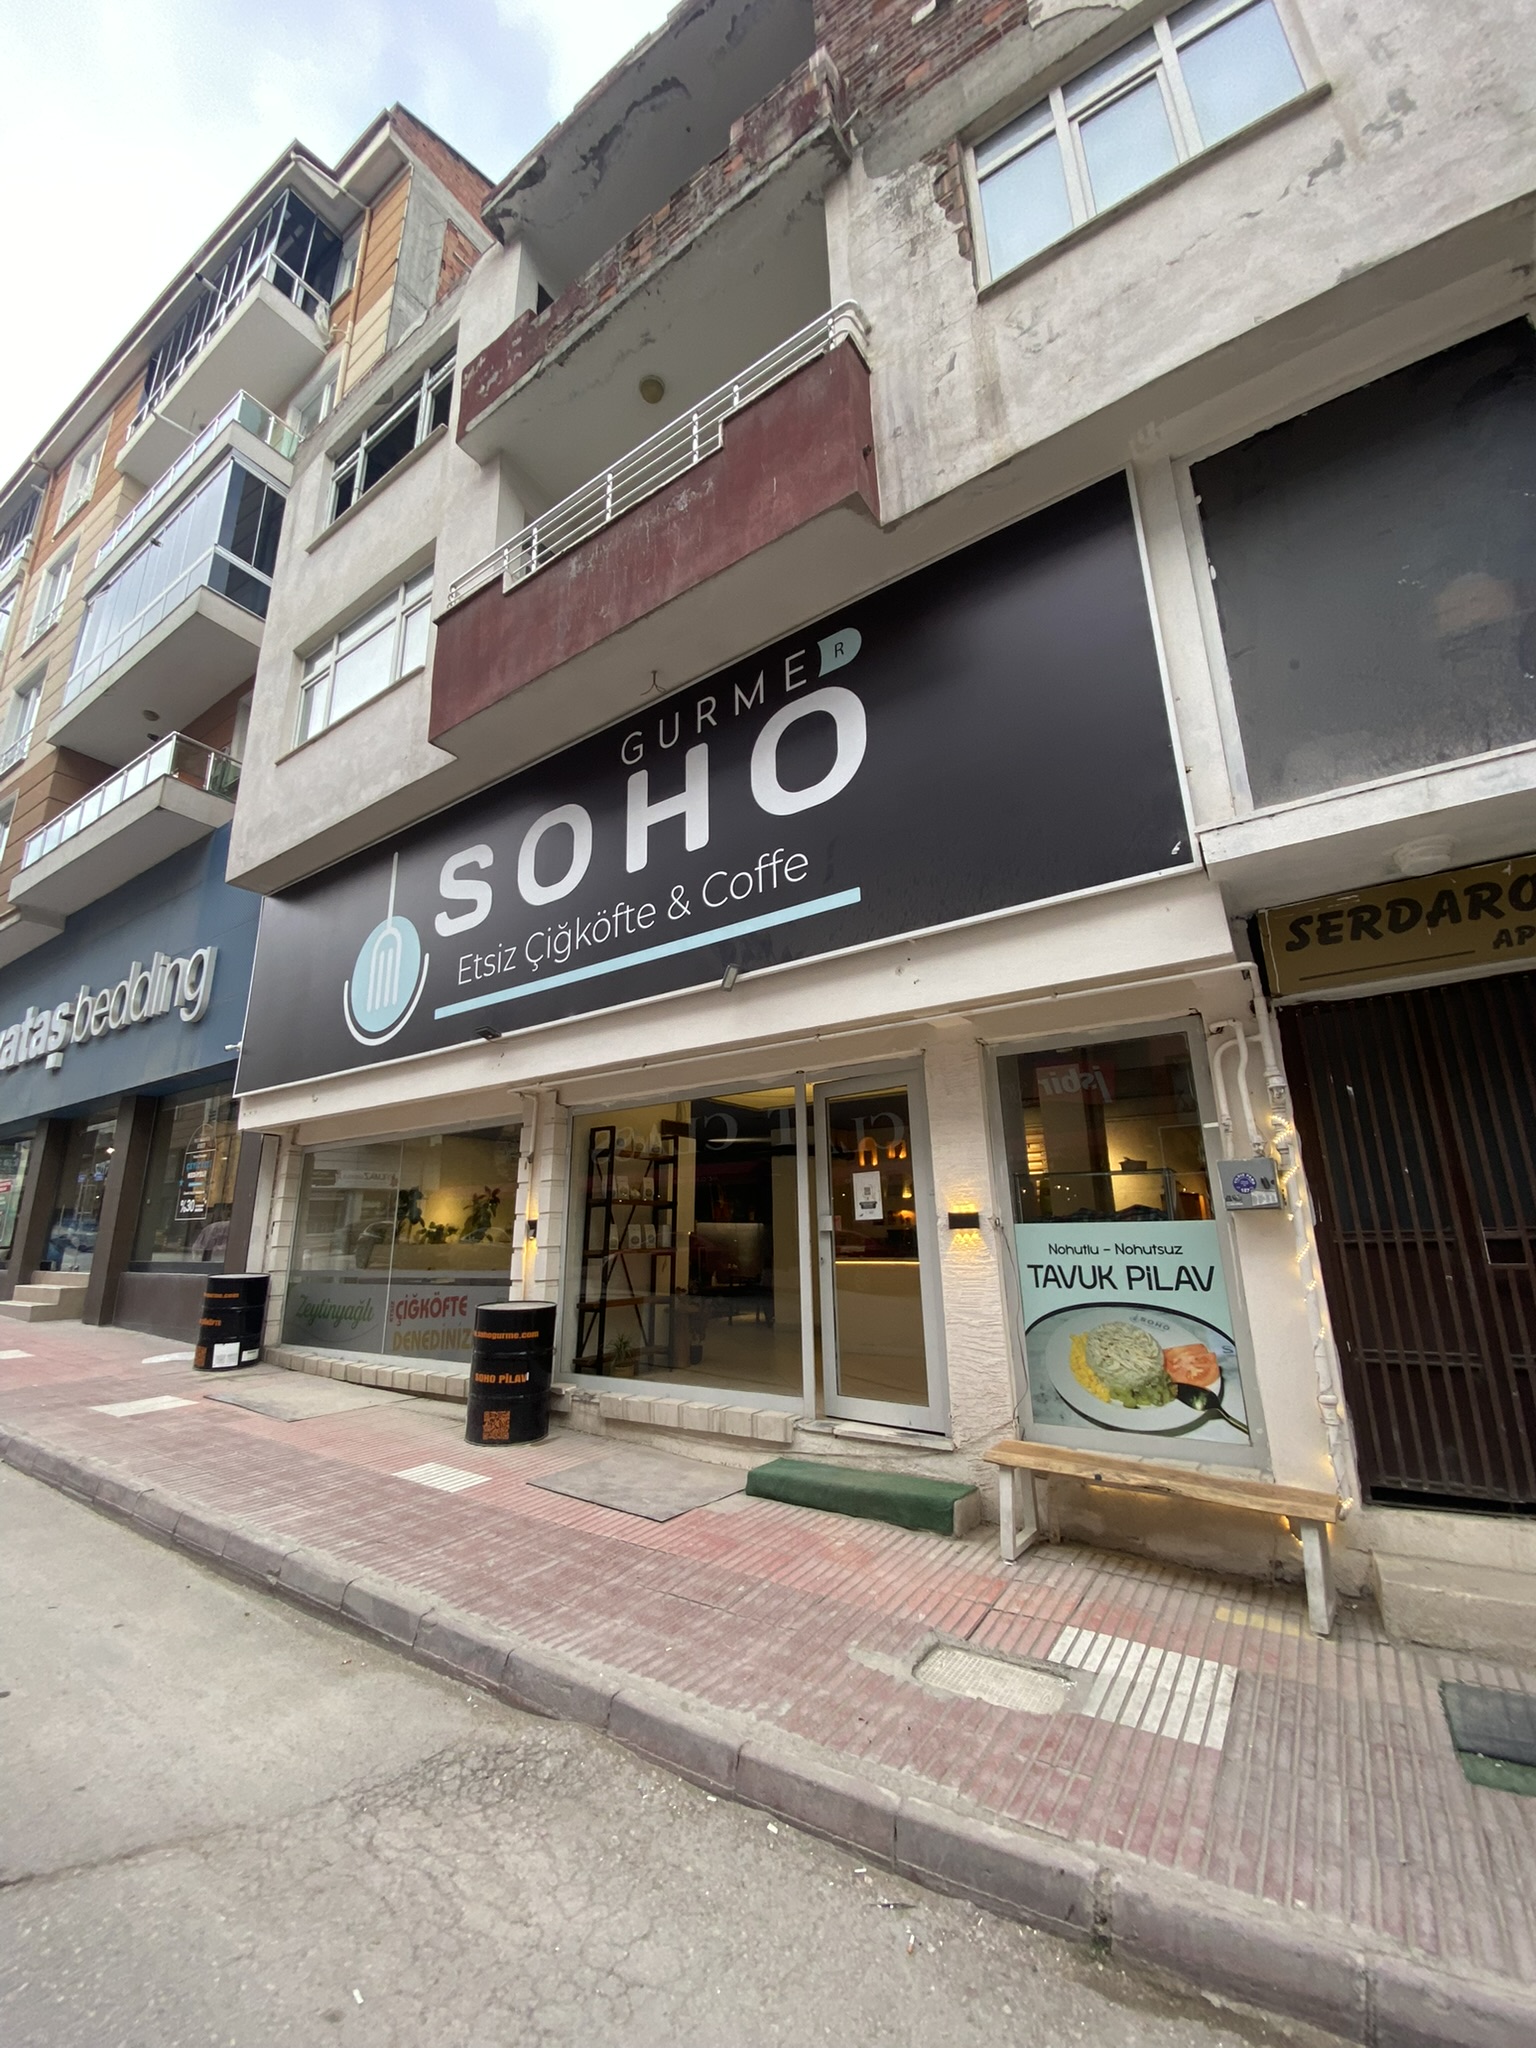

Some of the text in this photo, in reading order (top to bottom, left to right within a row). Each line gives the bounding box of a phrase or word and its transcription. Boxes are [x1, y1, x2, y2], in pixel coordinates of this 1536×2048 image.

[620, 649, 807, 766] GURME
[434, 686, 867, 938] SOHO
[458, 848, 809, 986] Etsiz Çiğköfte & Coffe
[72, 946, 218, 1043] bedding
[1027, 1264, 1118, 1290] TAVUK
[1049, 1243, 1100, 1256] Nohutlu
[1115, 1243, 1183, 1256] Nohutsuz
[396, 1292, 468, 1326] ÇİĞKÖFTE
